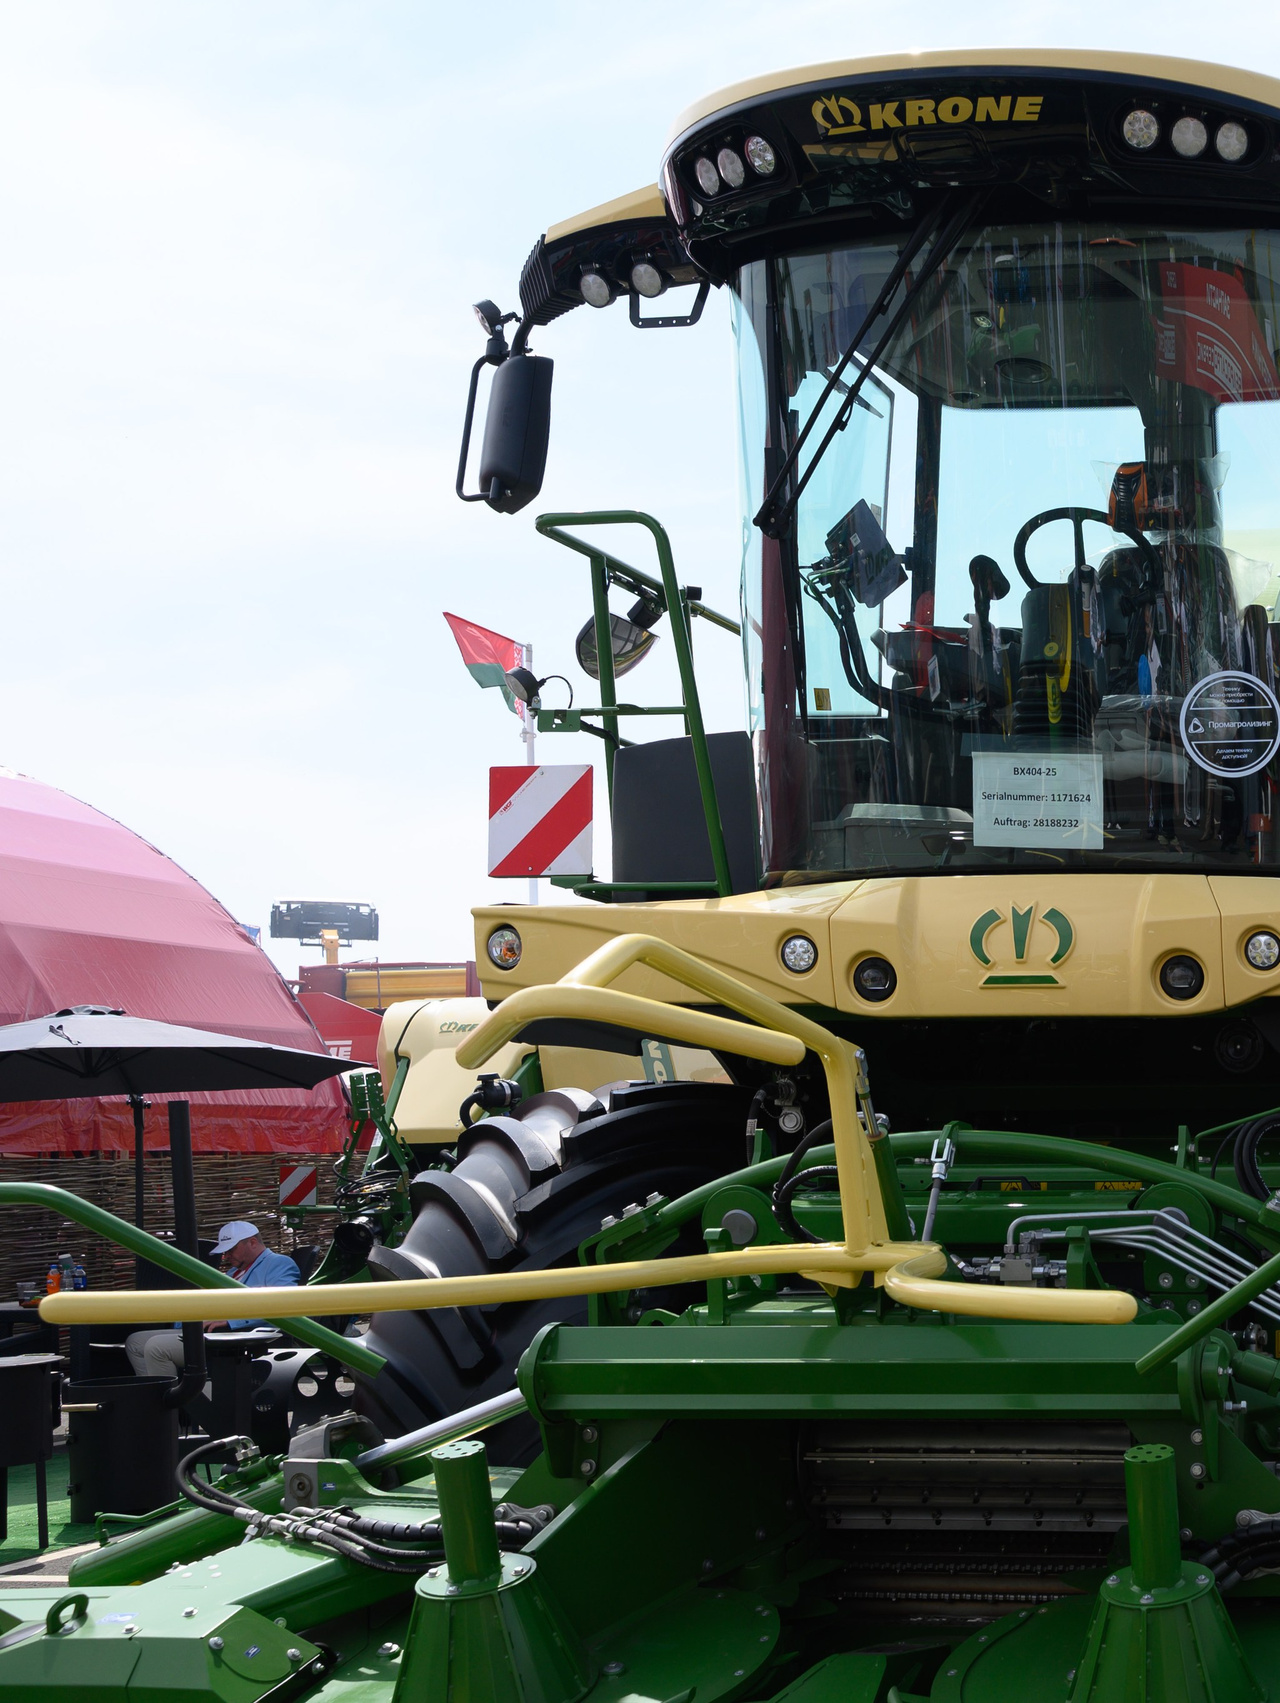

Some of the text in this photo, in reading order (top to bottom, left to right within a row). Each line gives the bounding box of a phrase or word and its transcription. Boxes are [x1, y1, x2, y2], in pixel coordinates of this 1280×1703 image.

[869, 95, 1044, 130] KRONE
[1208, 720, 1273, 730] Промагролизинг
[1013, 767, 1057, 777] BX404-25
[981, 791, 1091, 803] Serialnummer: 1171624
[993, 817, 1079, 829] Auftrag: 28188232
